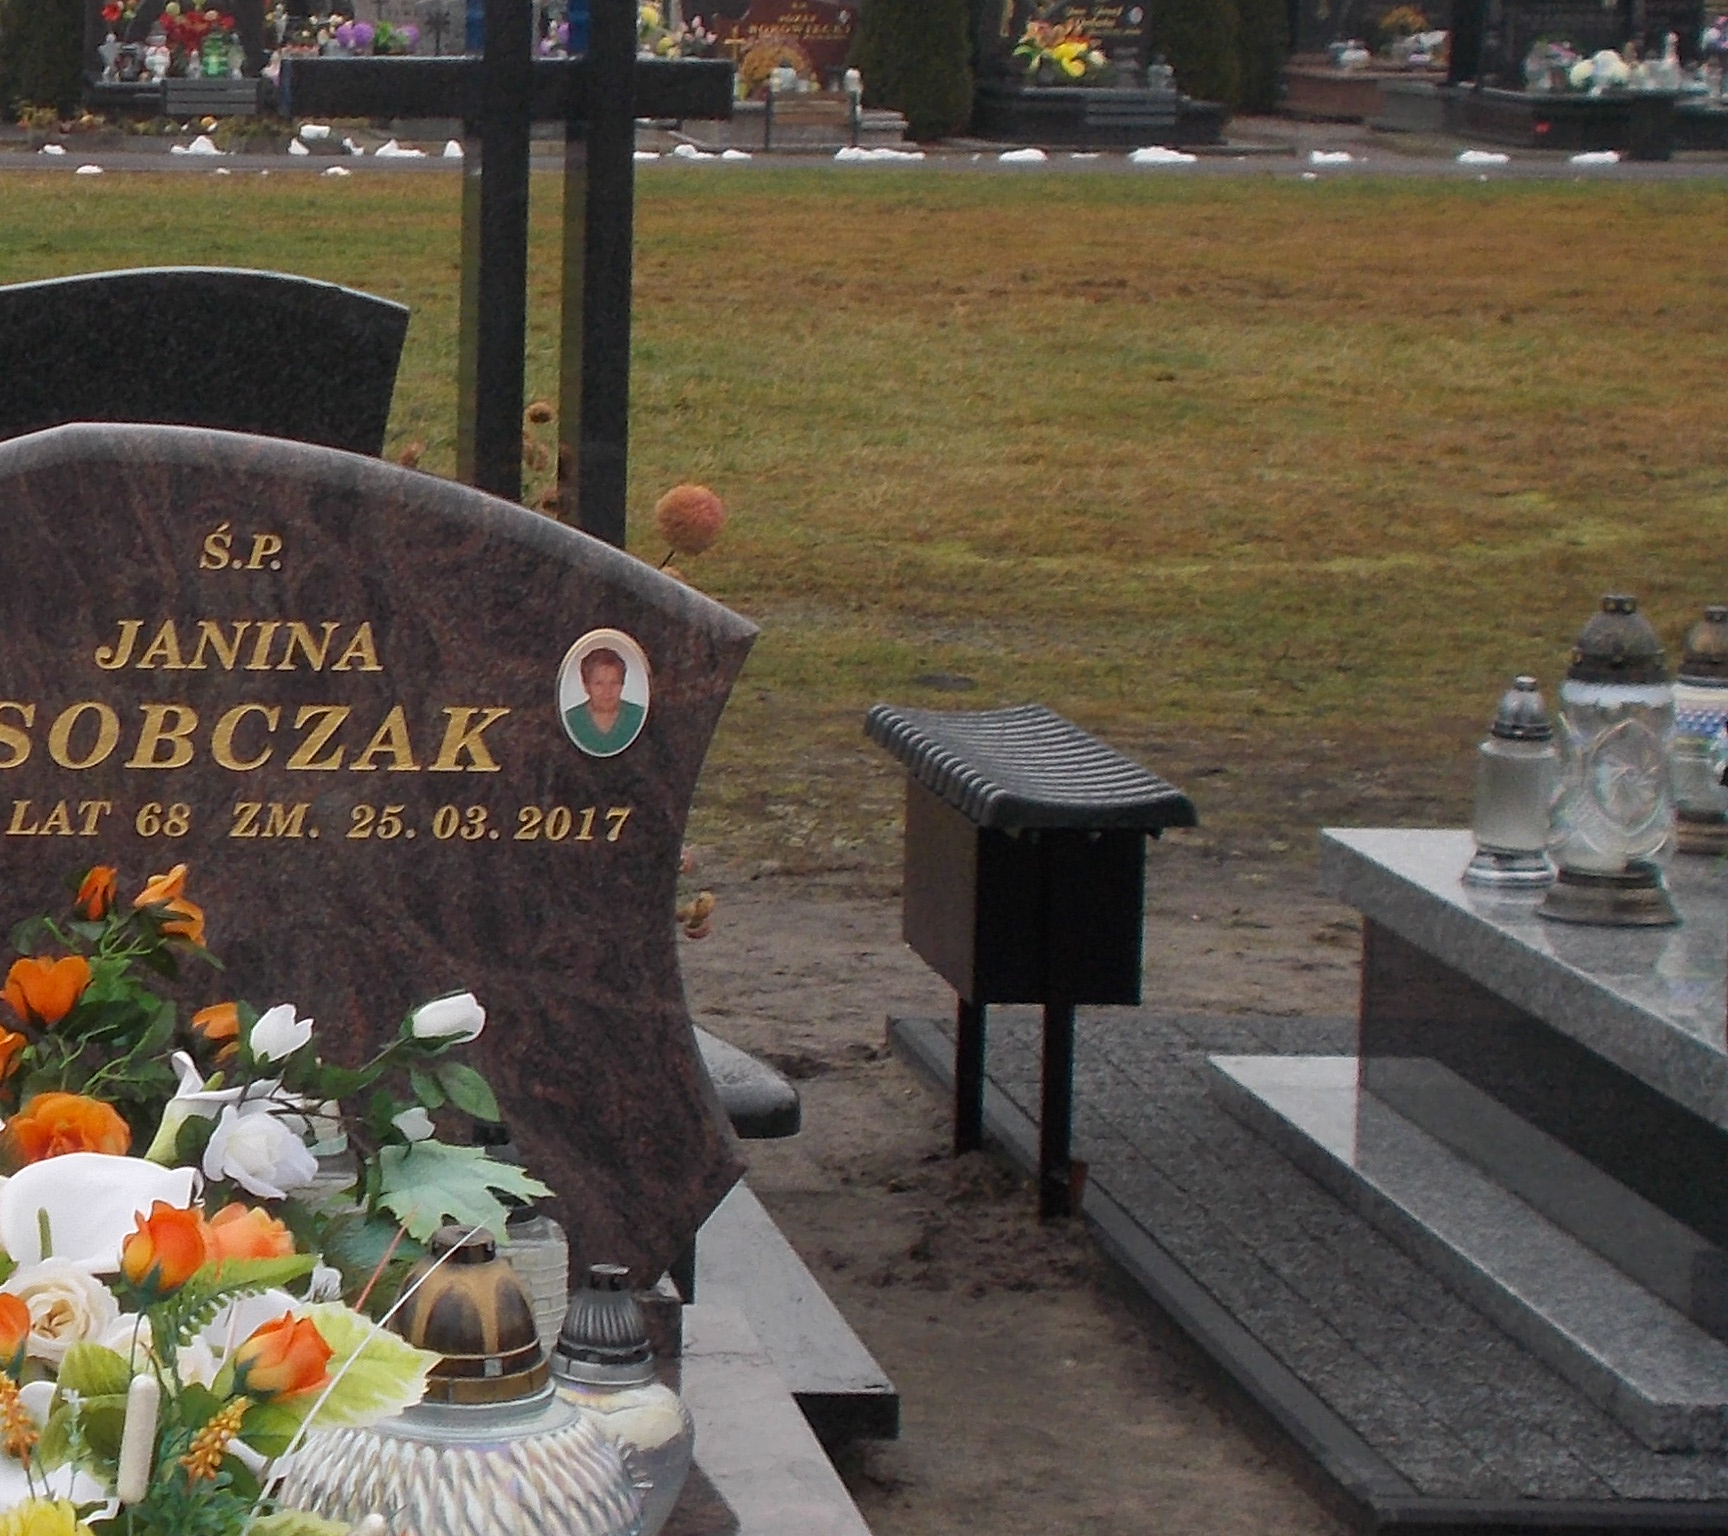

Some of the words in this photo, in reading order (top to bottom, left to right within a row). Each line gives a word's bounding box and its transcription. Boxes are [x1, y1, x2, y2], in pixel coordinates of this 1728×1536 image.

[200, 522, 283, 571] Ś.P.
[94, 618, 383, 672] JANINA
[5, 799, 113, 837] LAT
[134, 802, 192, 838] 68
[229, 801, 321, 839] ZM.
[513, 805, 633, 843] 2017
